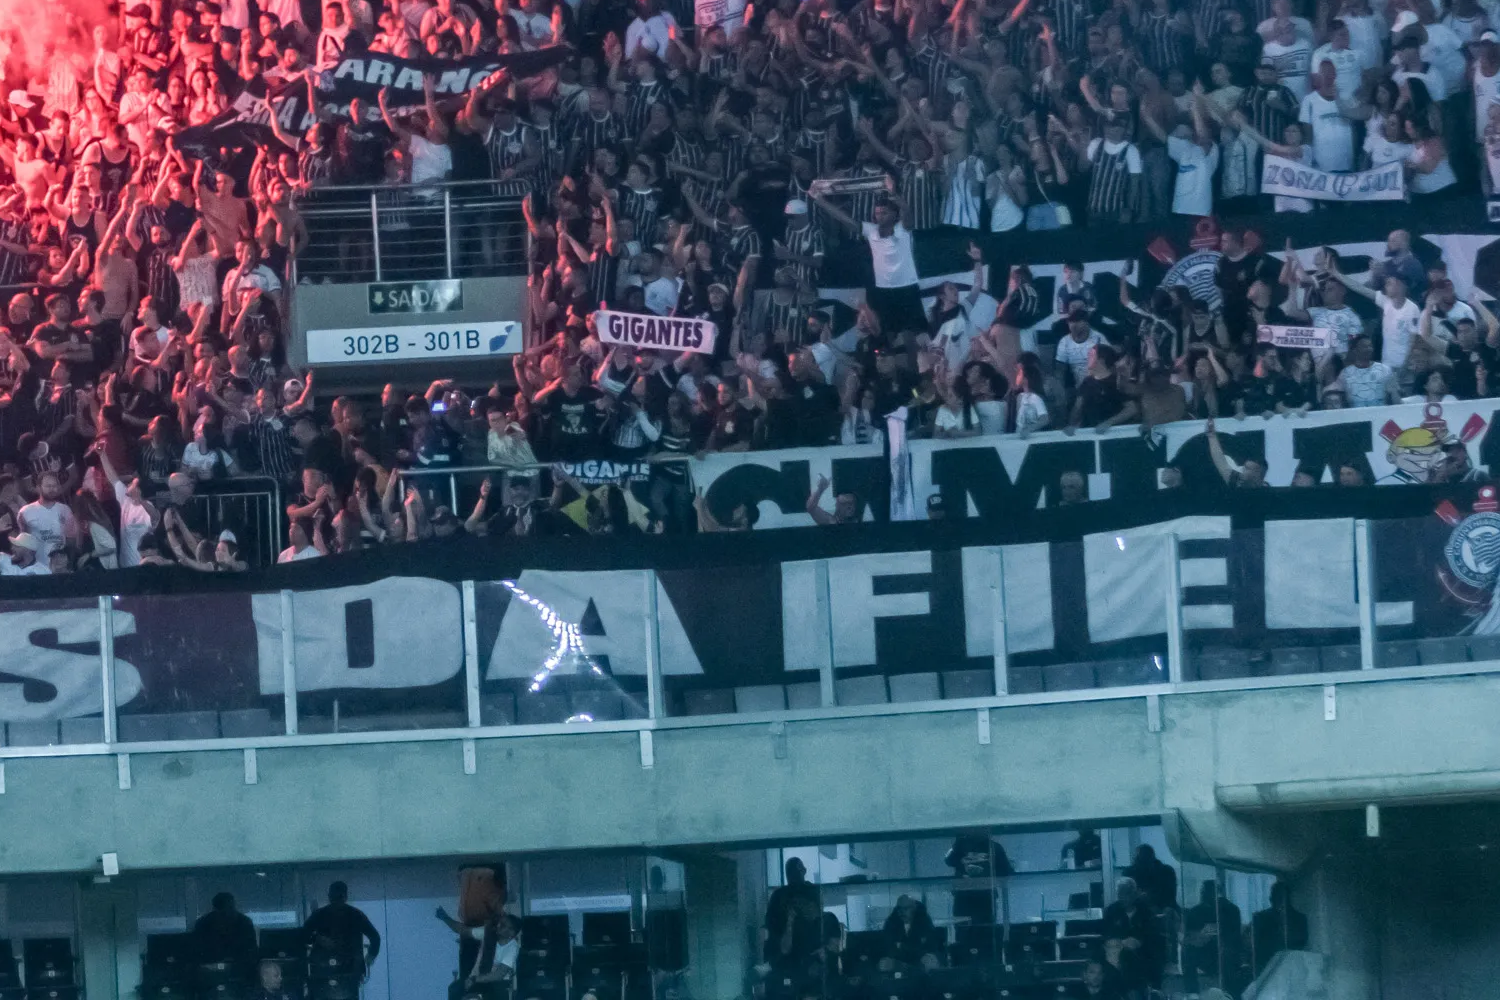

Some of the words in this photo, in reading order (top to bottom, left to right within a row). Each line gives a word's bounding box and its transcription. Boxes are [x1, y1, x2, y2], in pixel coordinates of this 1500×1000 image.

[343, 333, 400, 356] 302B
[424, 330, 481, 353] 301B
[608, 314, 704, 349] GIGANTES
[251, 569, 704, 695] DA
[781, 515, 1413, 671] FIEL
